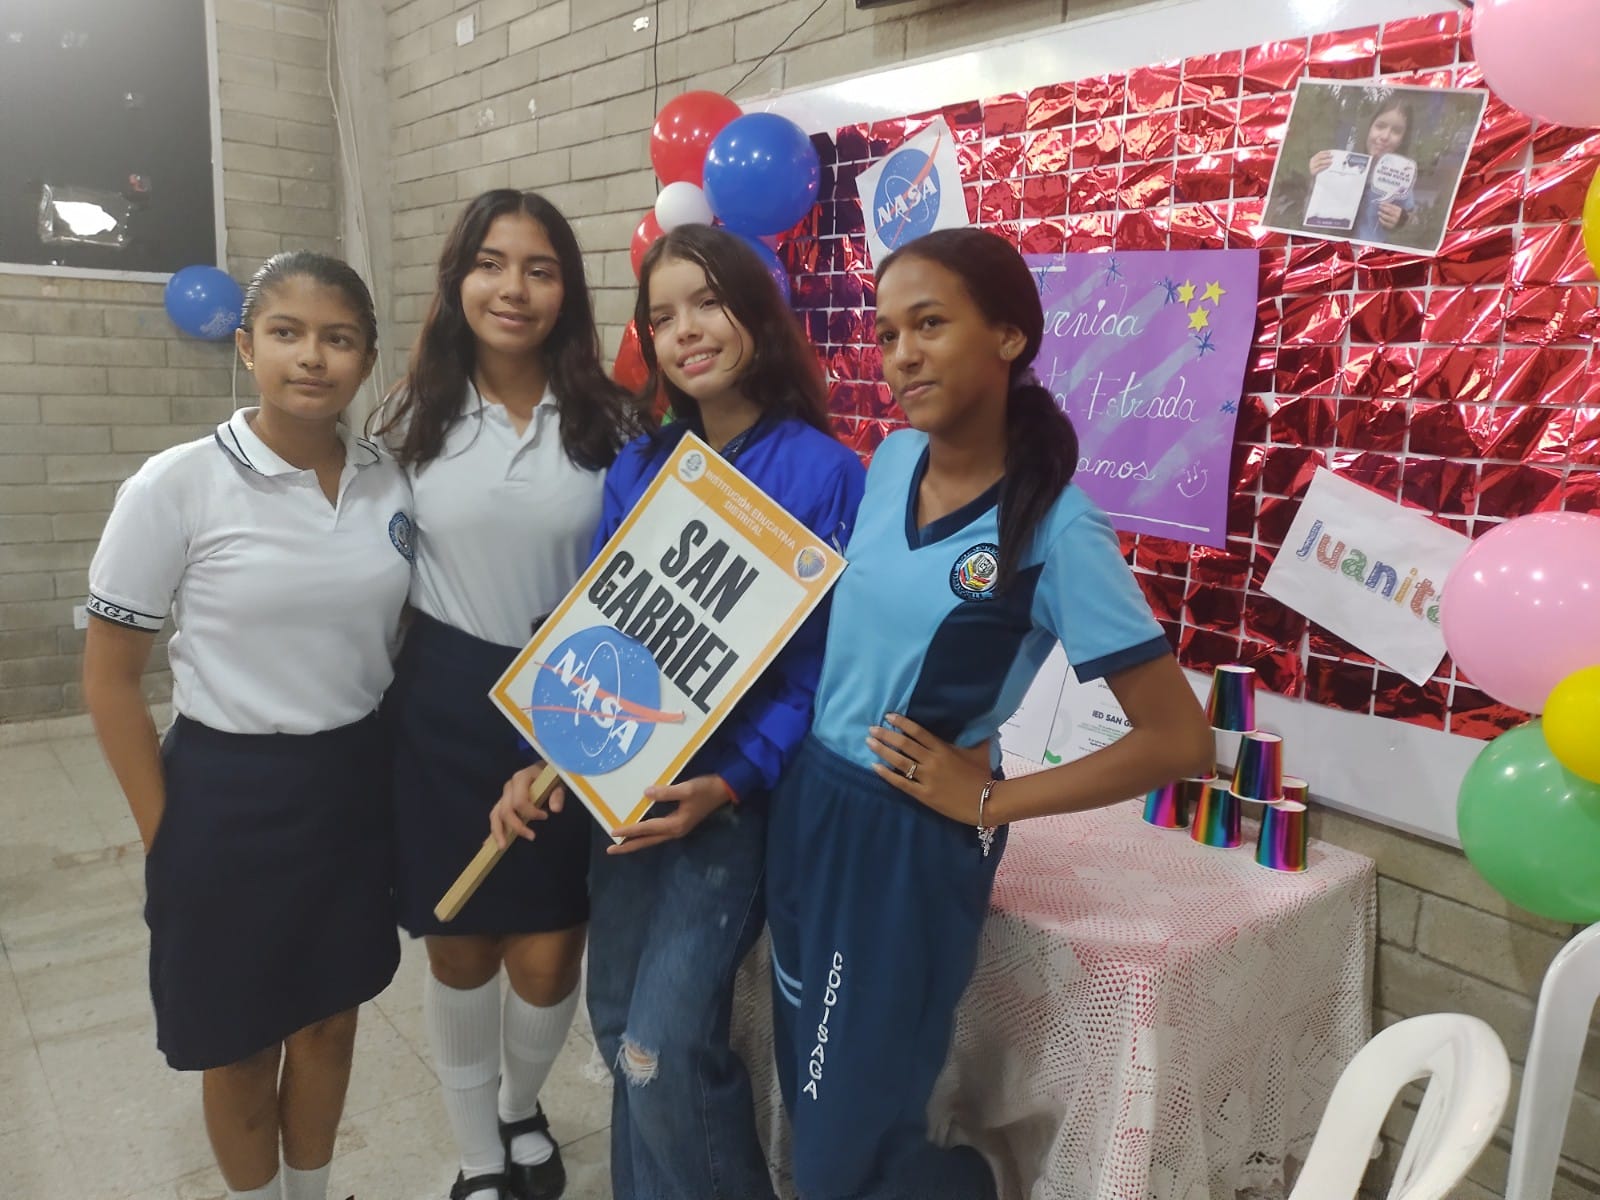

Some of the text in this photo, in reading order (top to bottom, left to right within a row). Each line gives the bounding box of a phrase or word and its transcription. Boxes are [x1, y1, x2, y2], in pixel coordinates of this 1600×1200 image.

[877, 175, 938, 227] NASA
[1043, 284, 1144, 337] venida
[1082, 371, 1200, 422] Estrada
[1076, 457, 1157, 480] amos
[704, 469, 796, 551] INSTITUCIÓN EDUCATIVA
[724, 500, 763, 537] DISTRITAL
[659, 519, 760, 624] SAN
[587, 550, 740, 715] GABRIEL
[552, 647, 641, 755] NASA
[1105, 713, 1123, 725] SAN
[803, 951, 843, 1100] CODISAGA
